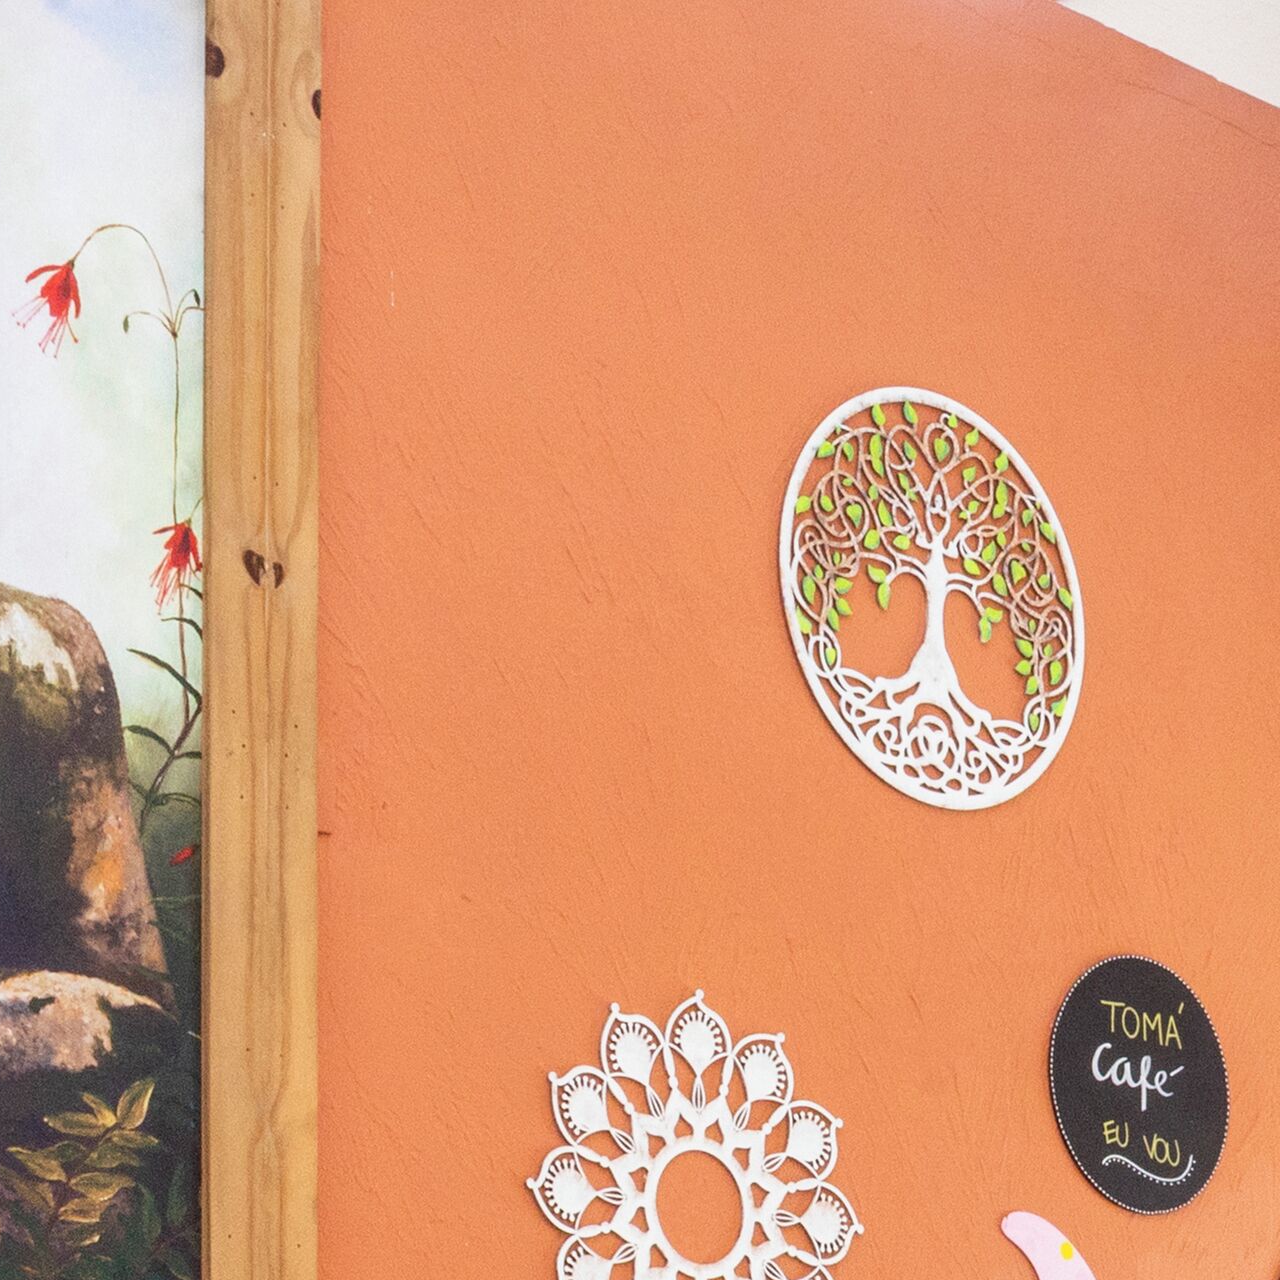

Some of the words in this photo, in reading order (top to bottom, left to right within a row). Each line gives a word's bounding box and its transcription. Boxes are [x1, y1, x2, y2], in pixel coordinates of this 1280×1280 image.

[1092, 1042, 1185, 1112] Café
[1103, 1119, 1130, 1148] EU
[1143, 1133, 1181, 1167] VOU
